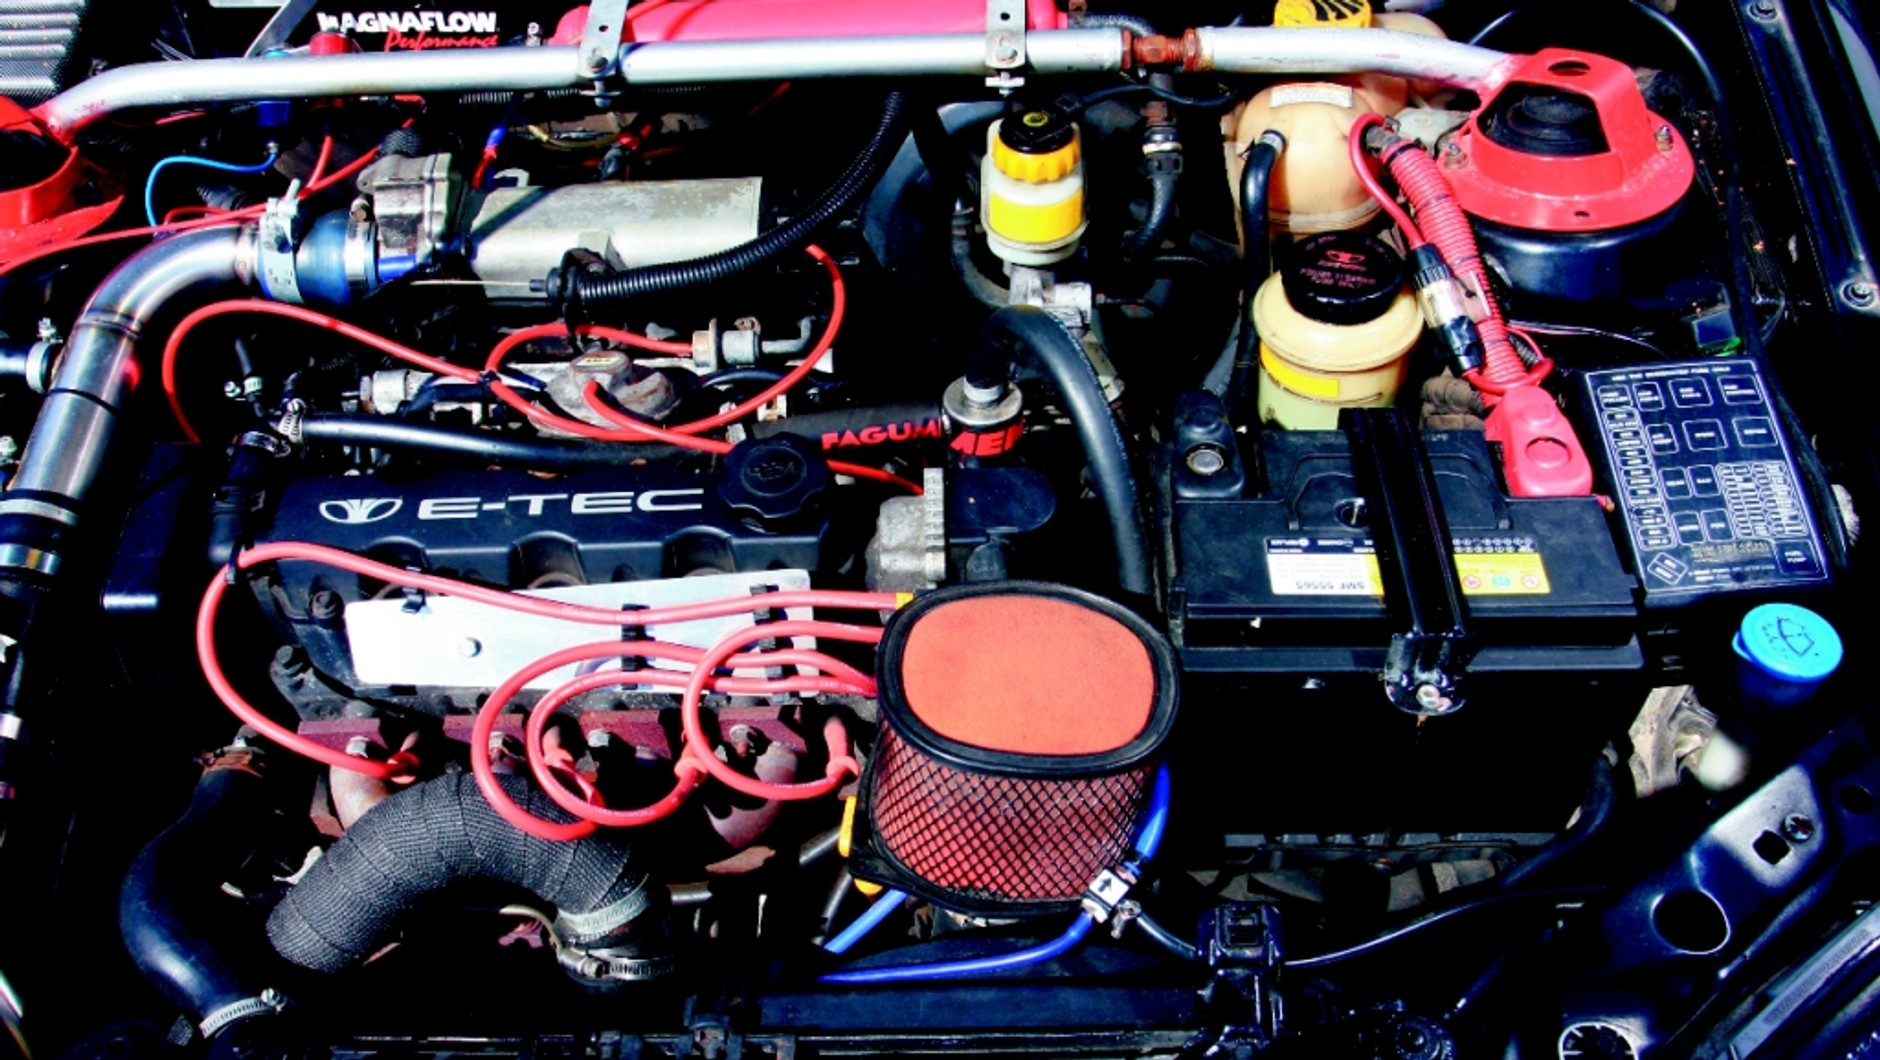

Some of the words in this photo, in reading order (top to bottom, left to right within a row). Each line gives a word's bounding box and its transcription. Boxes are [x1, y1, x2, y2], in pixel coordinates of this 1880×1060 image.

[316, 11, 497, 33] MAGNAFLOW
[383, 28, 498, 52] Performance
[417, 487, 704, 520] E-TEC
